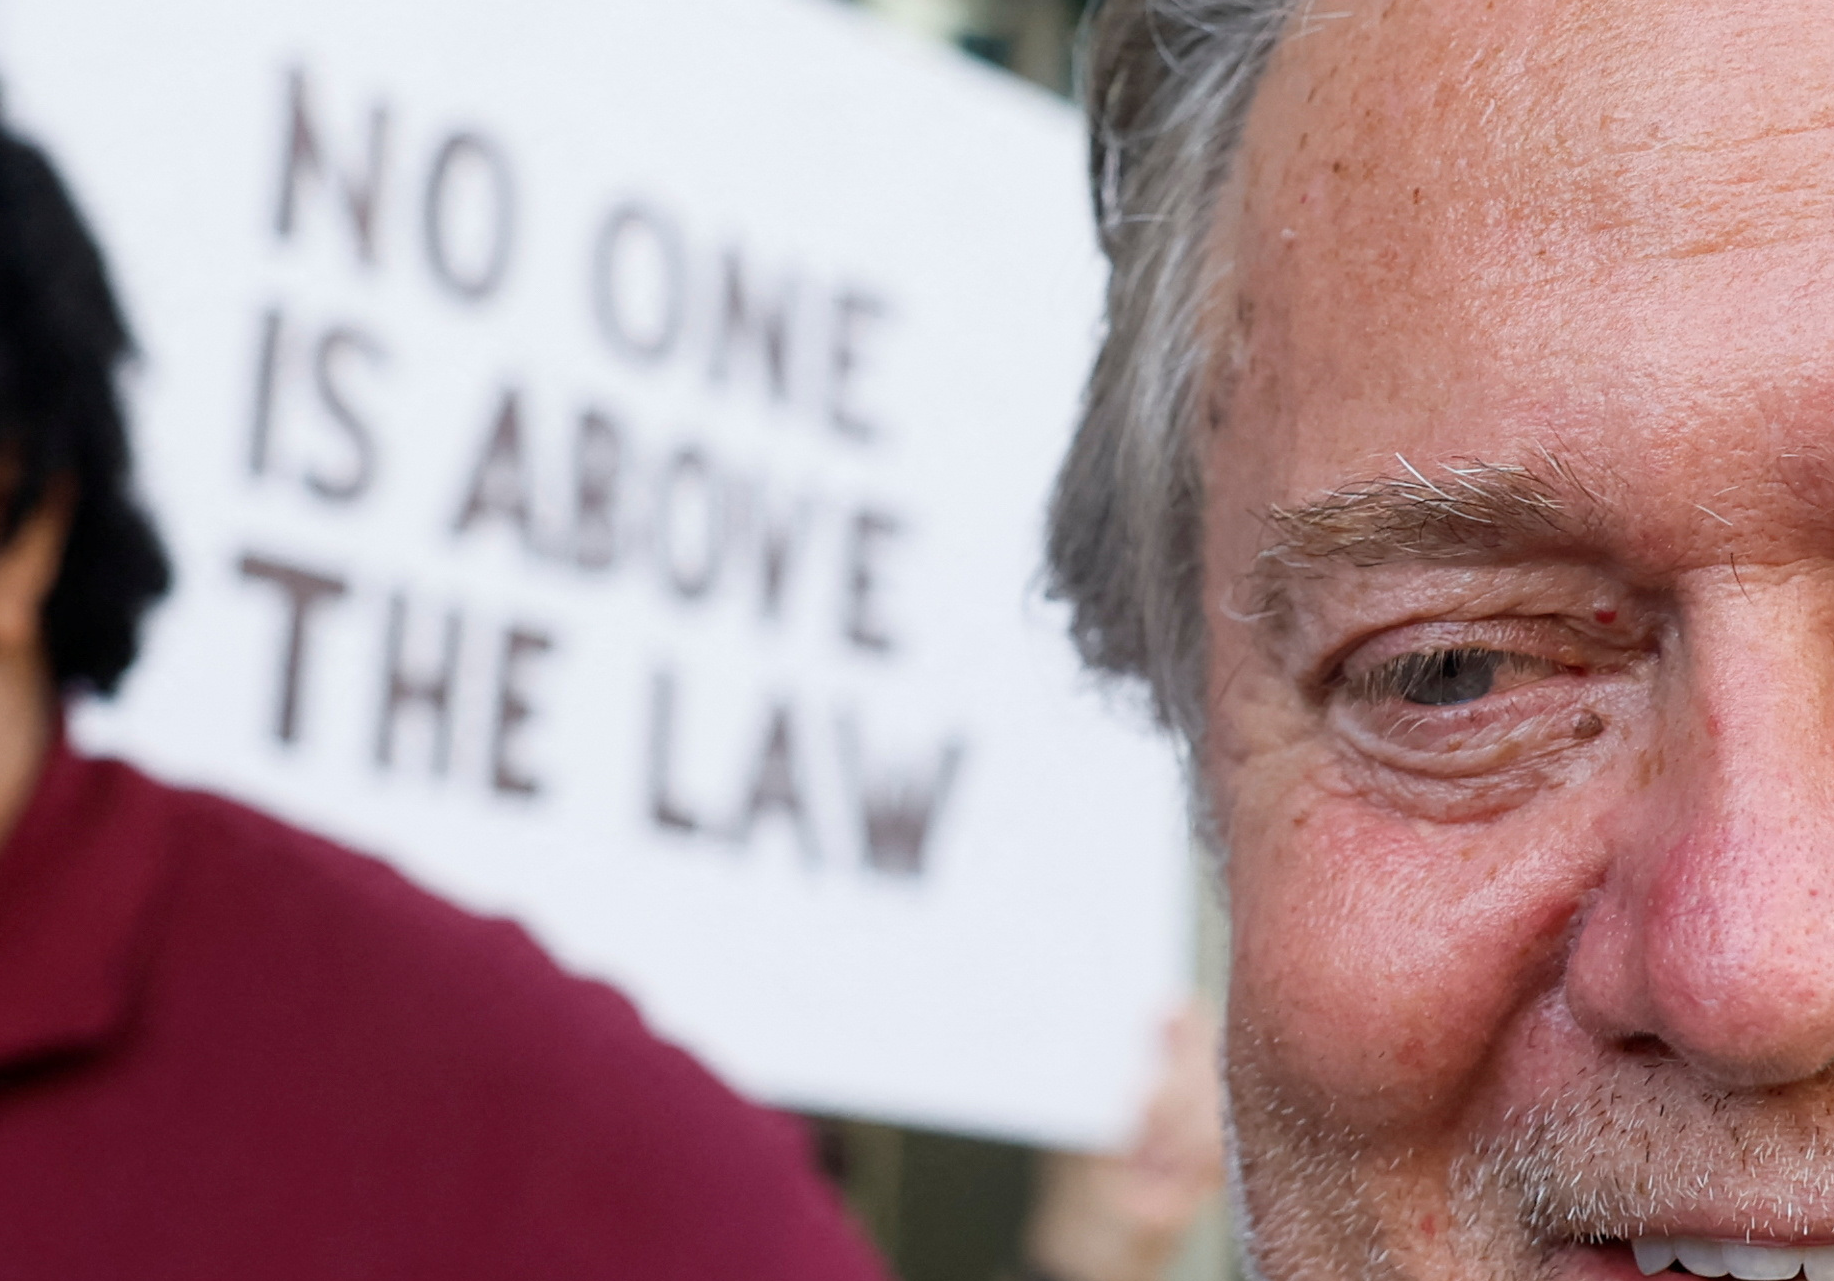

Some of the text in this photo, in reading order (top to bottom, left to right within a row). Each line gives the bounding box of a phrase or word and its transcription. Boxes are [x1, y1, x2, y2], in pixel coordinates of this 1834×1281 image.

[271, 55, 889, 444] NO ONE
[246, 309, 904, 659] IS ABOVE
[235, 552, 967, 878] THE LAW
